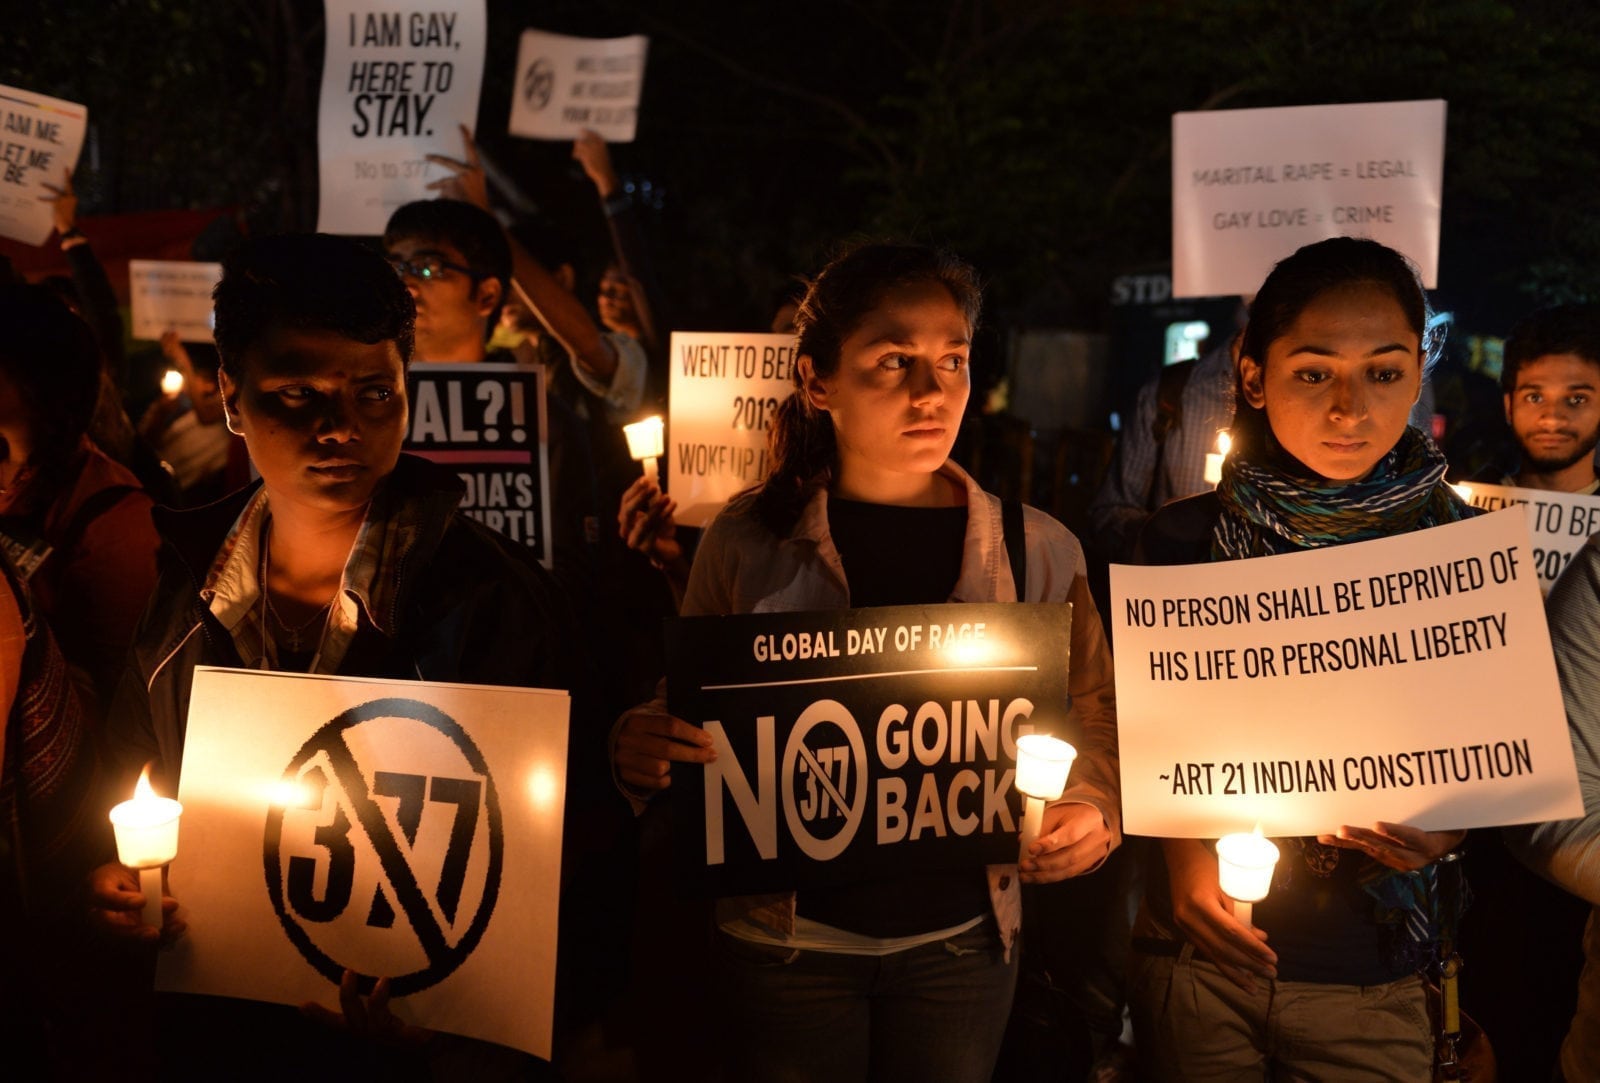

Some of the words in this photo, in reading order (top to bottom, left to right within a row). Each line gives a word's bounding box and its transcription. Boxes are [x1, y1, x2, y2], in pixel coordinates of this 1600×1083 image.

[349, 13, 355, 47] I
[363, 13, 401, 47] AM
[409, 12, 460, 50] GAY,
[349, 62, 415, 93] HERE
[422, 62, 454, 93] TO
[5, 112, 32, 136] AM
[352, 94, 435, 138] STAY.
[355, 161, 377, 179] No
[382, 161, 398, 179] to
[1192, 166, 1276, 188] MARITAL
[1282, 162, 1333, 183] RAPE
[1356, 160, 1417, 179] LEGAL
[1213, 212, 1252, 230] GAY
[1258, 208, 1308, 228] LOVE
[1332, 205, 1393, 224] CRIME
[682, 345, 730, 377] WENT
[734, 346, 756, 379] TO
[731, 446, 754, 480] UP
[1535, 502, 1562, 533] TO
[1126, 598, 1156, 628] NO
[1163, 594, 1251, 628] PERSON
[1256, 585, 1330, 621] SHALL
[1334, 580, 1365, 613] BE
[1369, 556, 1485, 608] DEPRIVED
[1490, 546, 1519, 584] OF
[753, 631, 840, 663] GLOBAL
[847, 627, 887, 656] DAY
[894, 625, 922, 652] OF
[1149, 651, 1189, 681] HIS
[1195, 649, 1238, 681] LIFE
[1243, 646, 1277, 679] OR
[1283, 632, 1408, 677] PERSONAL
[1411, 612, 1508, 661] LIBERTY
[876, 697, 1035, 770] GOING
[798, 745, 849, 822] 377
[1159, 763, 1215, 796] ~ART
[1222, 763, 1246, 796] 21
[1254, 758, 1335, 795] INDIAN
[1343, 739, 1534, 792] CONSTITUTION
[876, 768, 1026, 846] BACK
